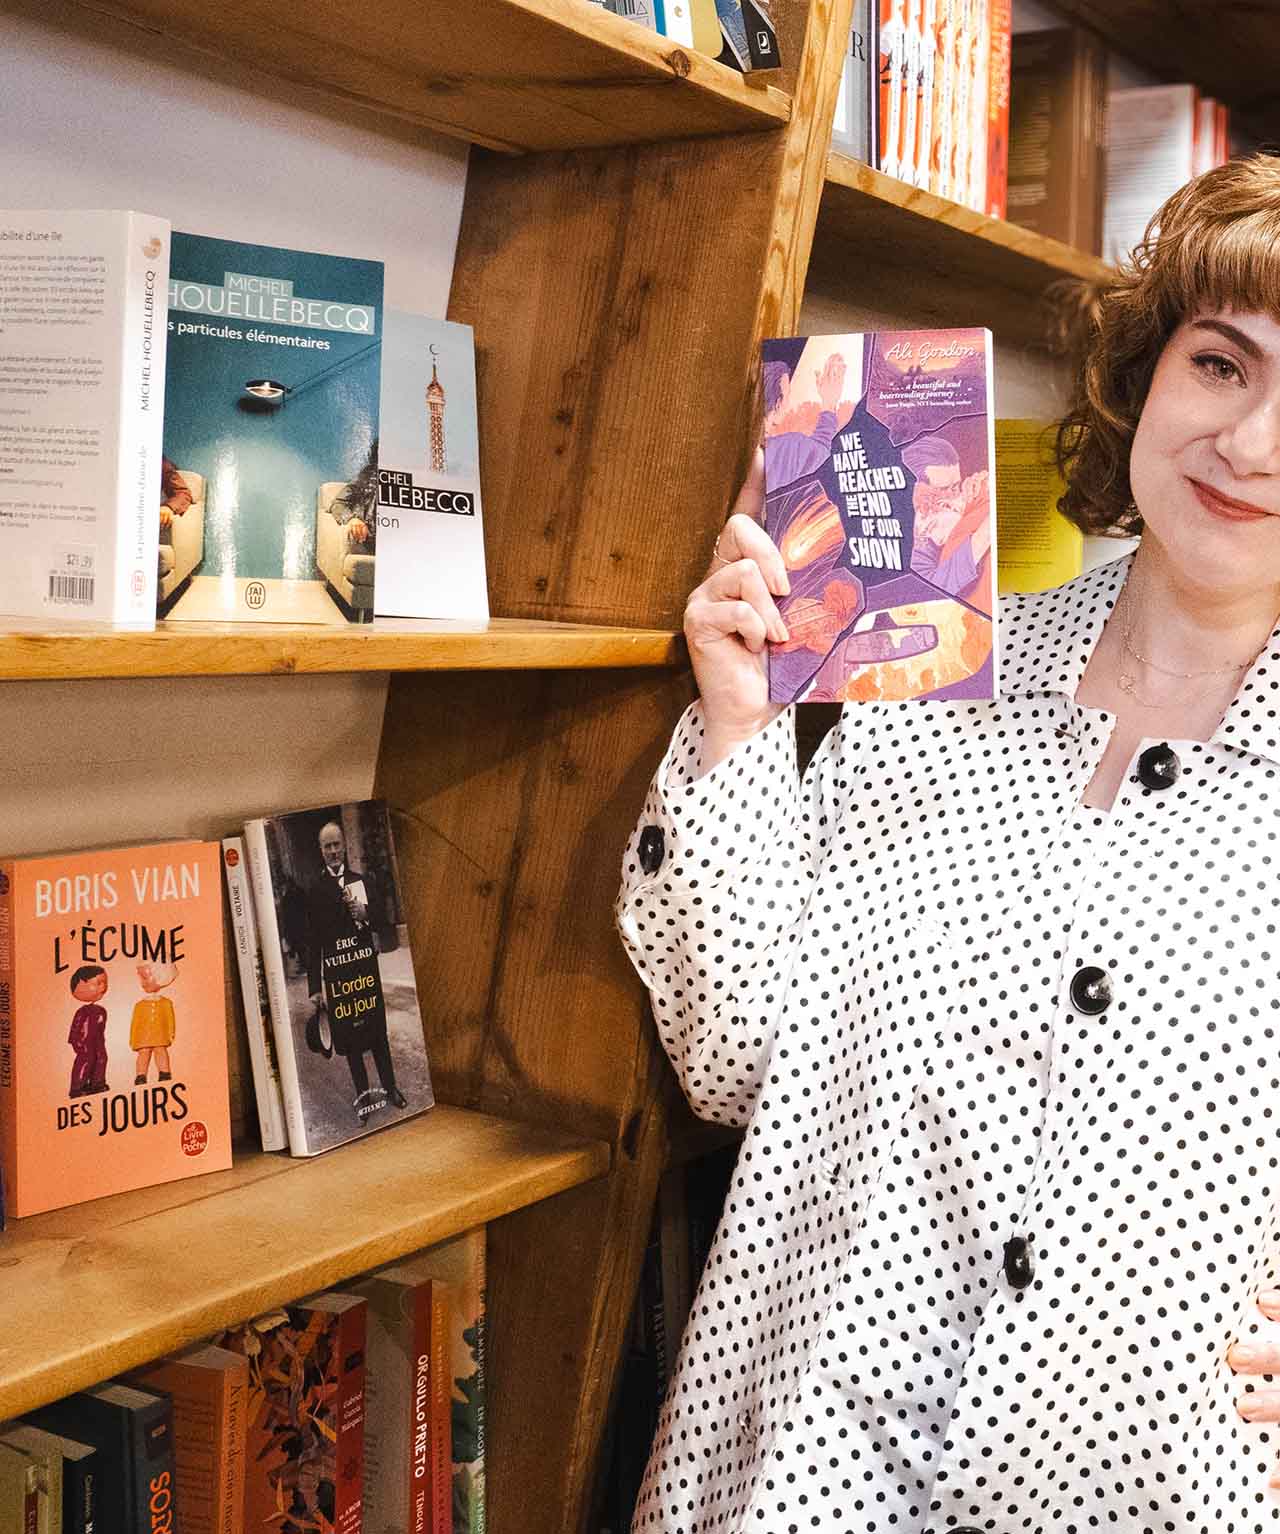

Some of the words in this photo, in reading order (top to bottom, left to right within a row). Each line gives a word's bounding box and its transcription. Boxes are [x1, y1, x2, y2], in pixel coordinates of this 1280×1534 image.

[229, 276, 289, 297] MICHEL
[143, 270, 157, 361] HOUELLEBECQ
[168, 284, 369, 332] HOUELLEBECQ
[178, 322, 243, 340] particules
[246, 328, 331, 350] élémentaires
[918, 340, 977, 368] Gordon
[141, 366, 151, 412] MICHEL
[880, 391, 925, 401] heartrending
[925, 391, 954, 401] journey
[912, 379, 945, 391] beautiful
[947, 380, 962, 388] and
[840, 432, 862, 452] WE
[833, 450, 868, 473] HAVE
[379, 471, 409, 487] CHEL
[839, 466, 906, 493] REACHED
[378, 485, 471, 514] LLEBECQ
[846, 494, 860, 518] THE
[860, 492, 892, 517] END
[862, 519, 876, 536] OF
[877, 519, 903, 537] OUR
[849, 537, 903, 571] SHOW
[34, 870, 119, 919] BORIS
[131, 862, 201, 906] VIAN
[231, 884, 242, 917] VOLTAIRE
[54, 919, 186, 975] L'ÉCUME
[336, 936, 358, 950] ÉRIC
[325, 947, 373, 967] VUILLARD
[331, 975, 375, 998] L'ordre
[335, 1002, 351, 1019] du
[353, 996, 377, 1017] jour
[57, 1101, 93, 1131] DES
[98, 1082, 189, 1136] JOURS
[182, 1142, 207, 1152] Poche
[183, 1129, 205, 1140] Livre
[415, 1354, 429, 1421] ORGULLO
[415, 1422, 428, 1478] PRIETO
